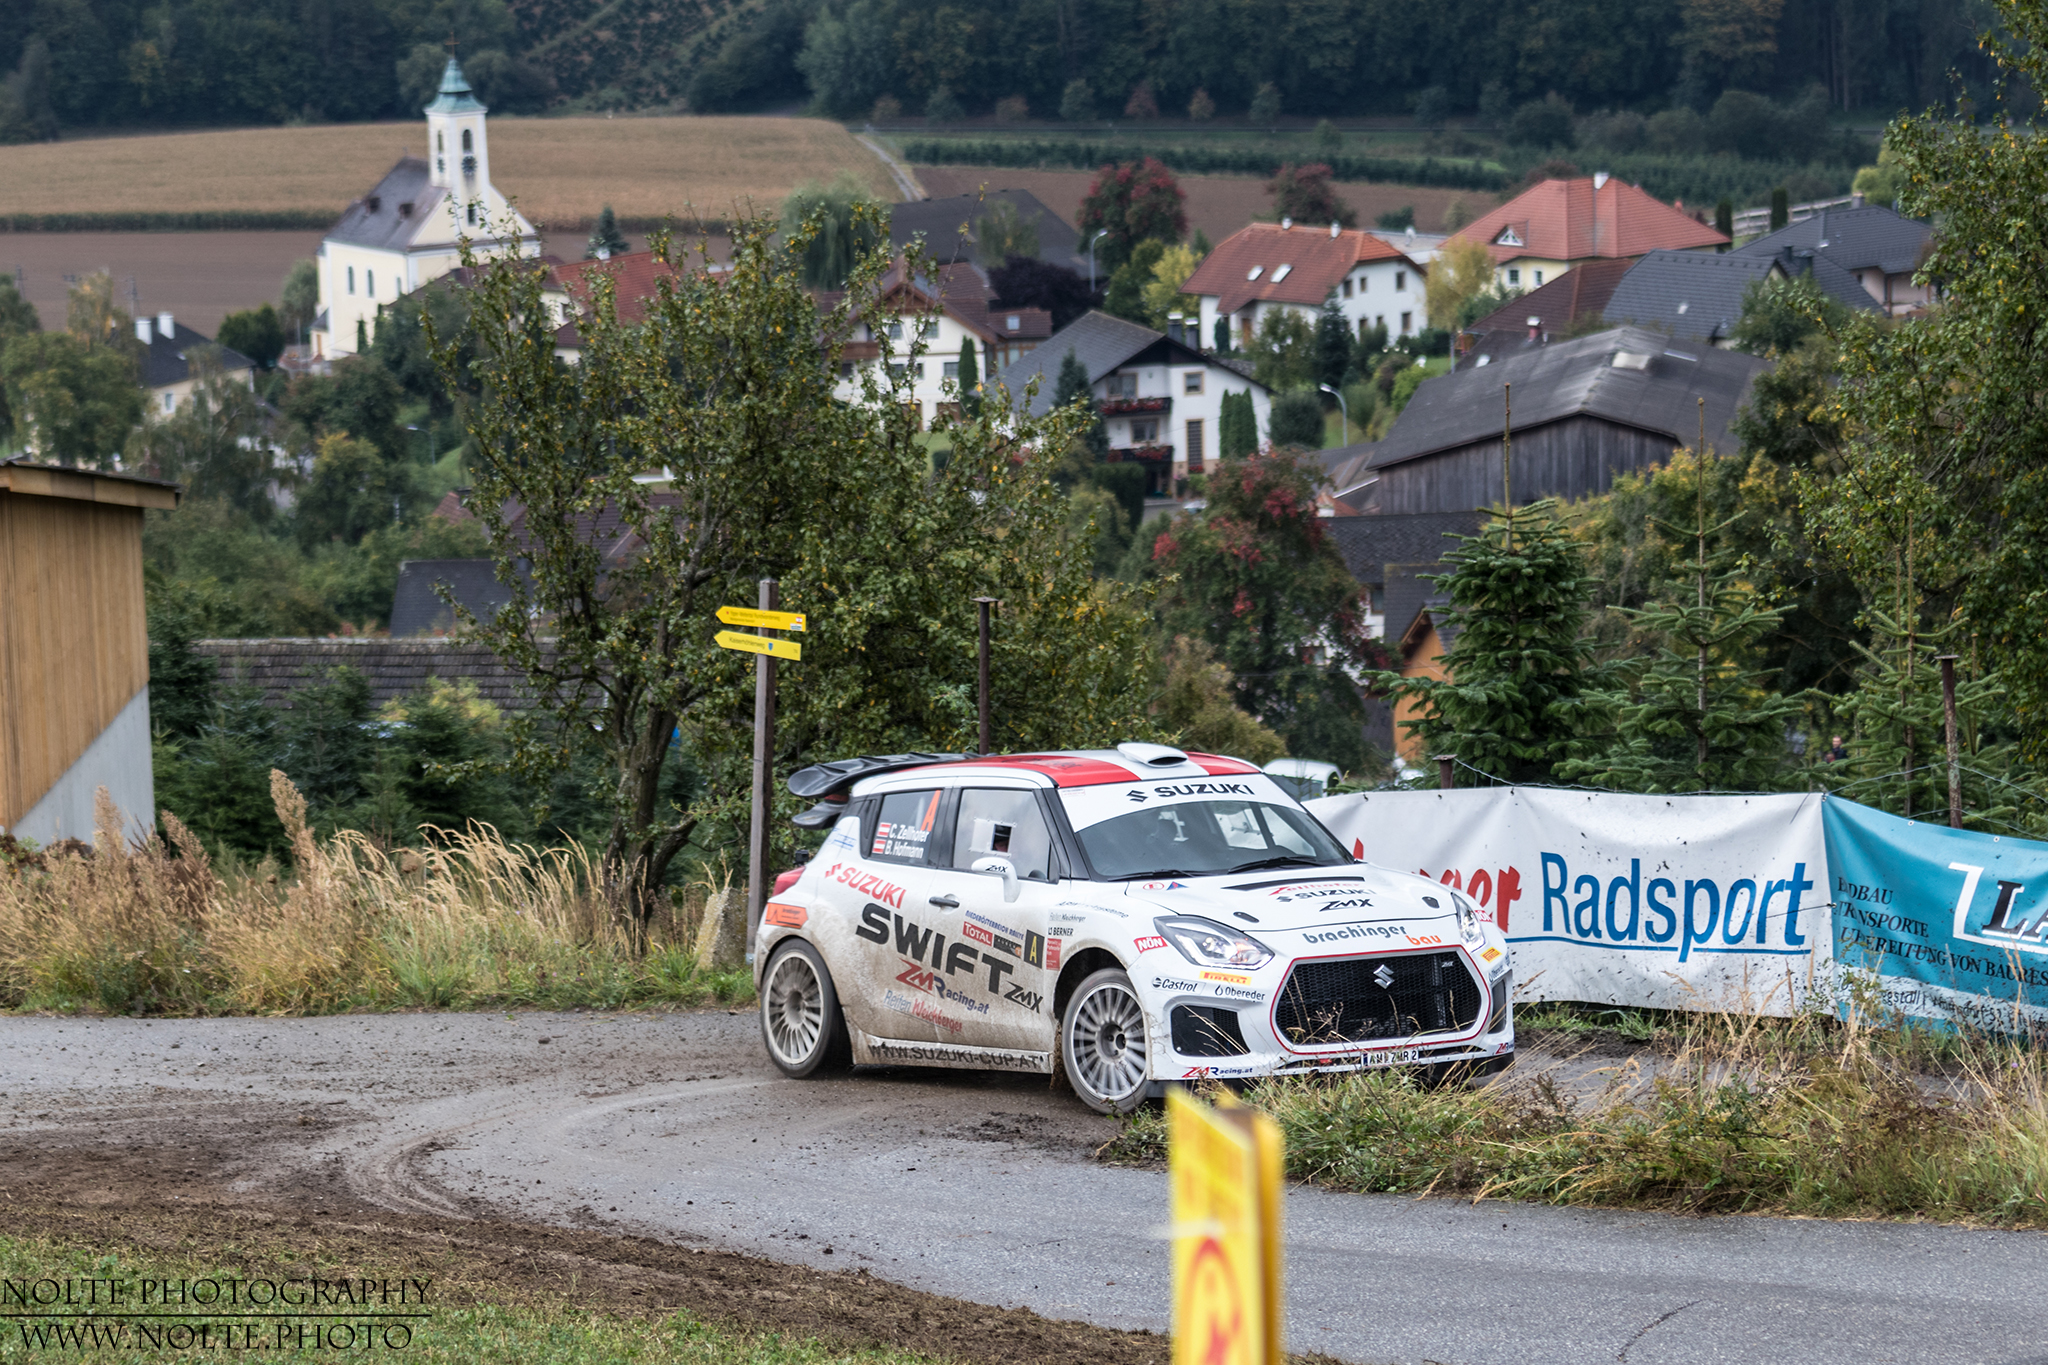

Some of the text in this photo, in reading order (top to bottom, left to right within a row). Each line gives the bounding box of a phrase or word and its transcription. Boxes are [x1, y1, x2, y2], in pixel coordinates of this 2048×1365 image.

[1154, 783, 1255, 798] SUZUKI
[920, 789, 942, 832] A
[893, 841, 925, 859] Hofmann
[836, 866, 907, 910] SUZUKI
[1294, 888, 1378, 900] SUZUKI
[1317, 898, 1375, 912] ZMX
[1540, 851, 1814, 964] Radsport
[964, 922, 992, 945] TOTAL
[1053, 927, 1074, 937] BERNER
[1301, 924, 1443, 946] brachinger bau
[855, 902, 1014, 996] SWIFT
[1029, 935, 1038, 964] A
[1136, 936, 1164, 952] NÖN
[1949, 952, 1982, 975] VON
[1161, 978, 1199, 993] Castrol
[1203, 972, 1248, 985] PIRELLI
[1003, 980, 1044, 1014] ZMX
[1224, 986, 1266, 1001] Obereder
